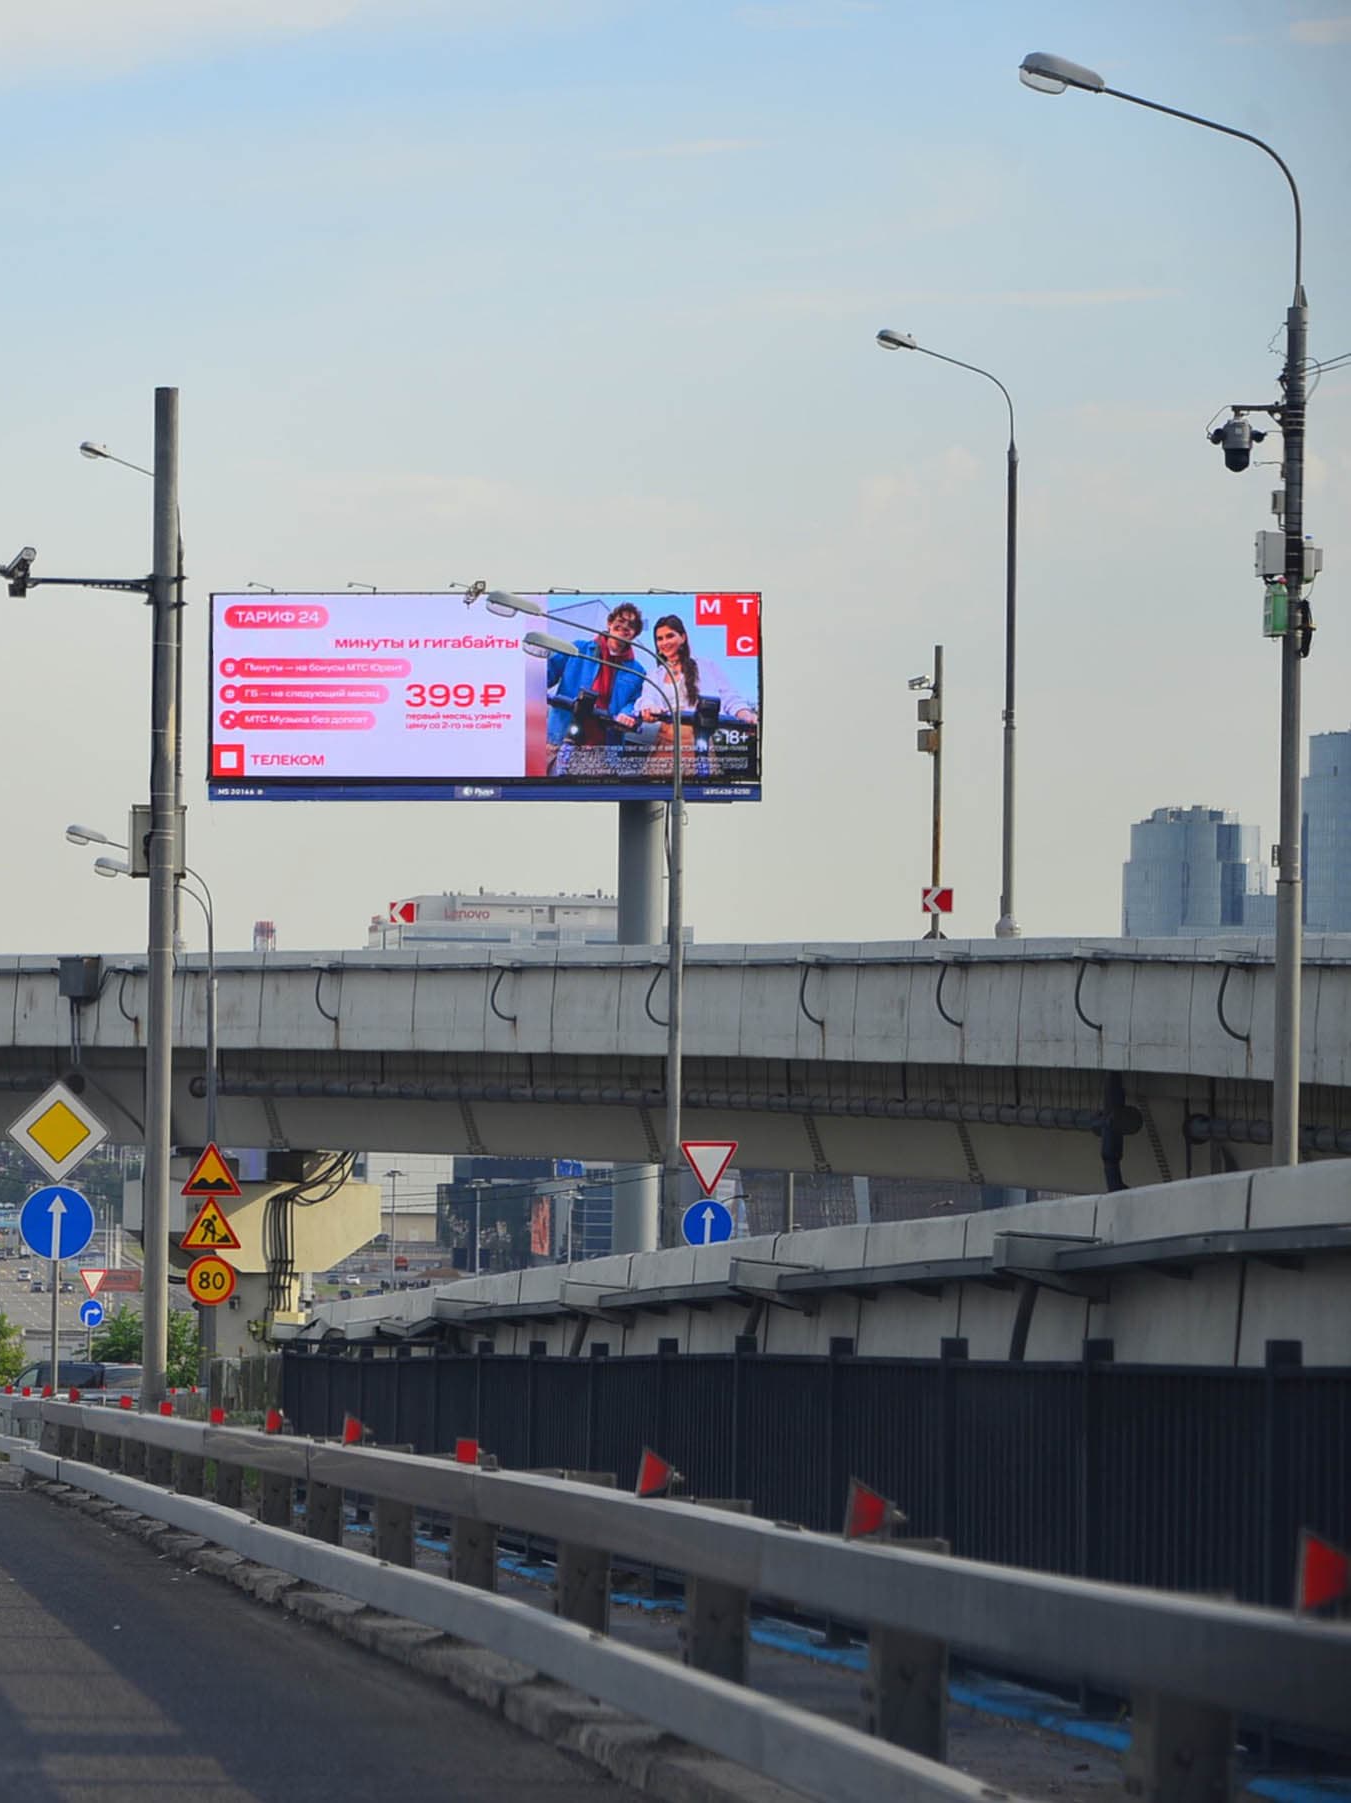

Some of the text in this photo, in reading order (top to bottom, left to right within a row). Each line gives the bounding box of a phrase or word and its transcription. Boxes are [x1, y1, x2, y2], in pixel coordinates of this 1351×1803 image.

[235, 610, 321, 624] ТАРИФ 24
[334, 634, 519, 652] минуты и гигабайты
[405, 683, 475, 708] 399
[244, 714, 268, 723] МТС
[270, 714, 309, 725] Музыка
[405, 712, 441, 721] первый
[474, 712, 512, 721] узнайте
[405, 722, 427, 730] цену
[441, 721, 461, 730] 2-го
[475, 720, 503, 729] сайте
[723, 729, 749, 745] 18+
[250, 754, 325, 766] ТЕЛЕКОМ
[443, 905, 491, 920] Lenovo
[198, 1271, 225, 1290] 80
